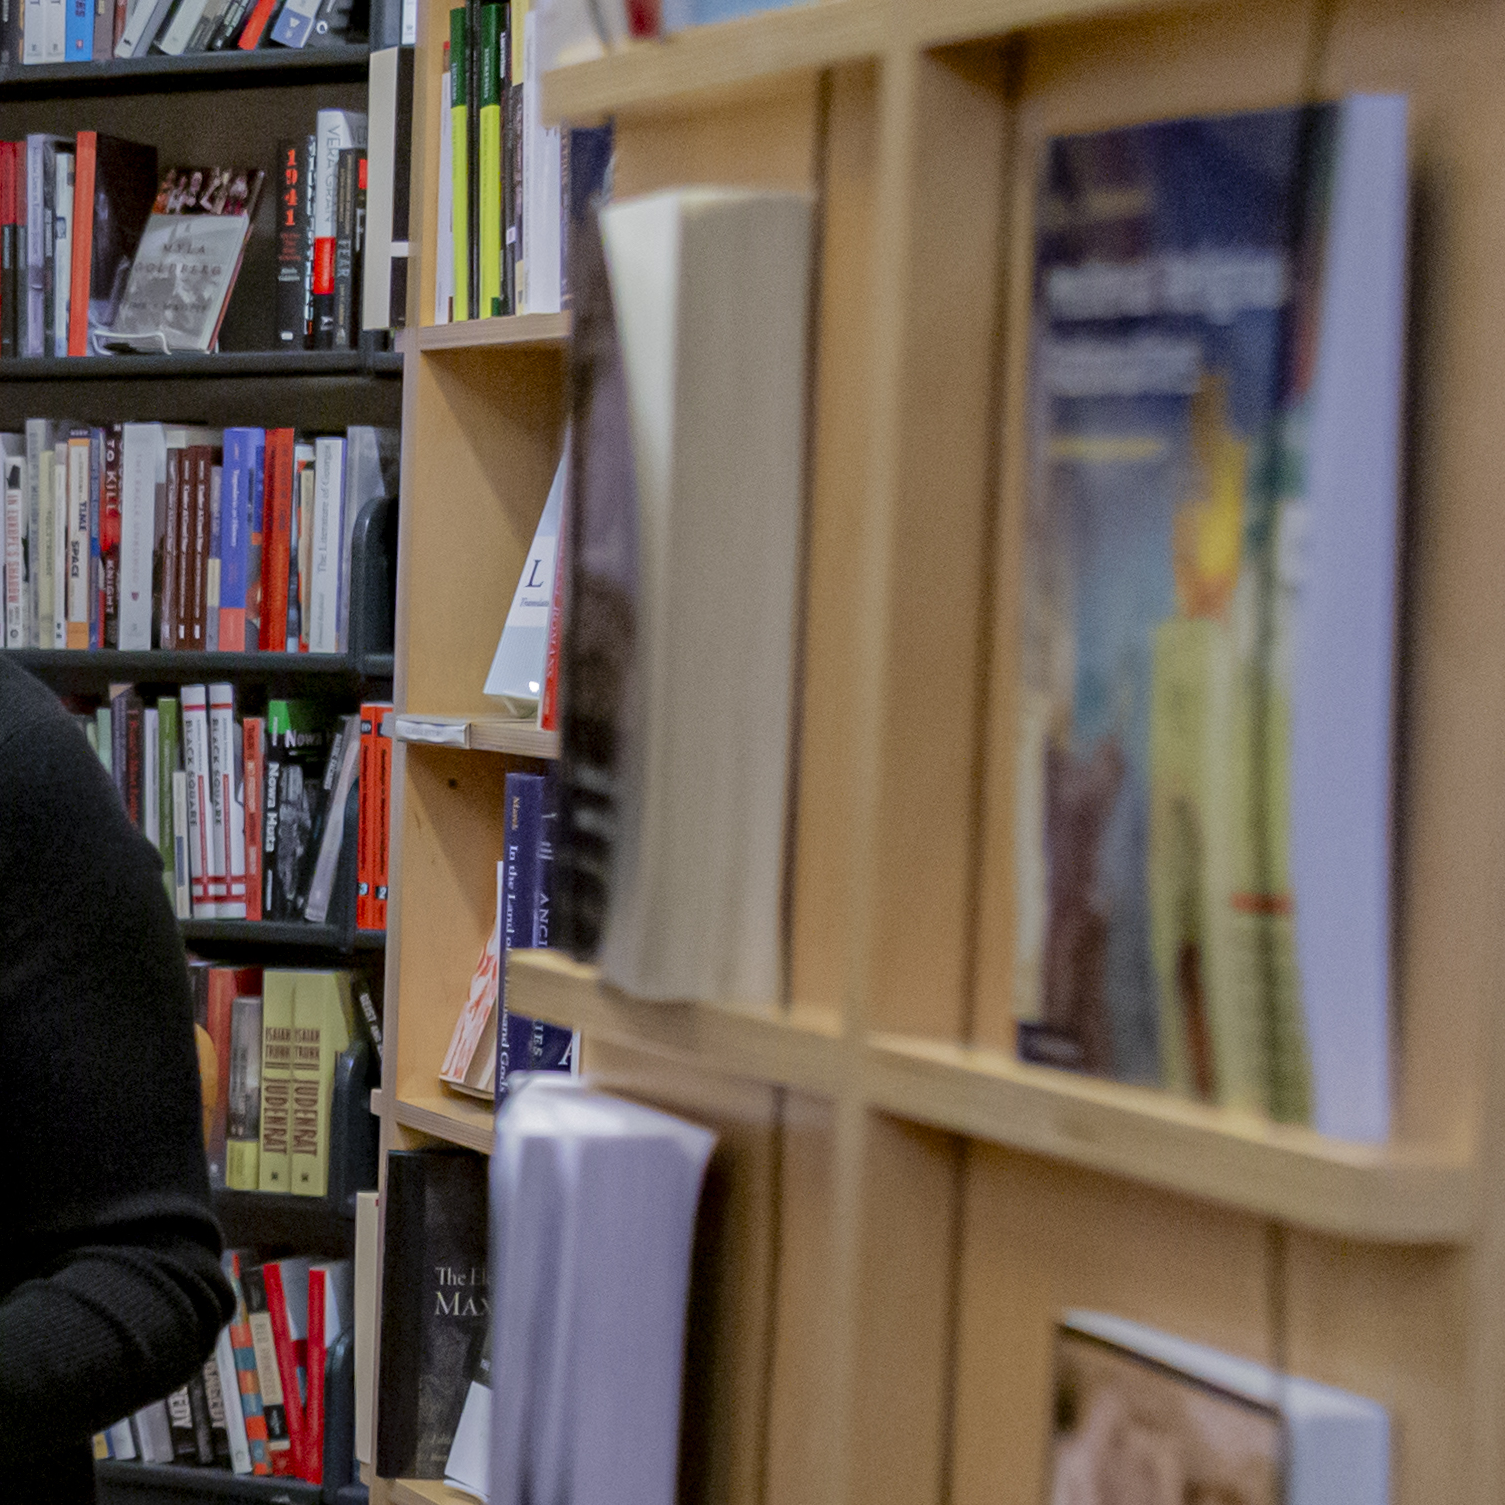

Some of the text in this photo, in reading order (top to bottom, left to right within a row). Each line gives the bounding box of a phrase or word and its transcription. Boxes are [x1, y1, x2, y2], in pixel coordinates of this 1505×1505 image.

[78, 500, 87, 532] TIME
[70, 540, 80, 578] SPACE
[186, 720, 198, 828] BLACK SQUARE
[210, 718, 221, 826] BLACK SQUARE
[499, 844, 518, 1094] In the Land Gods
[434, 1266, 467, 1286] The
